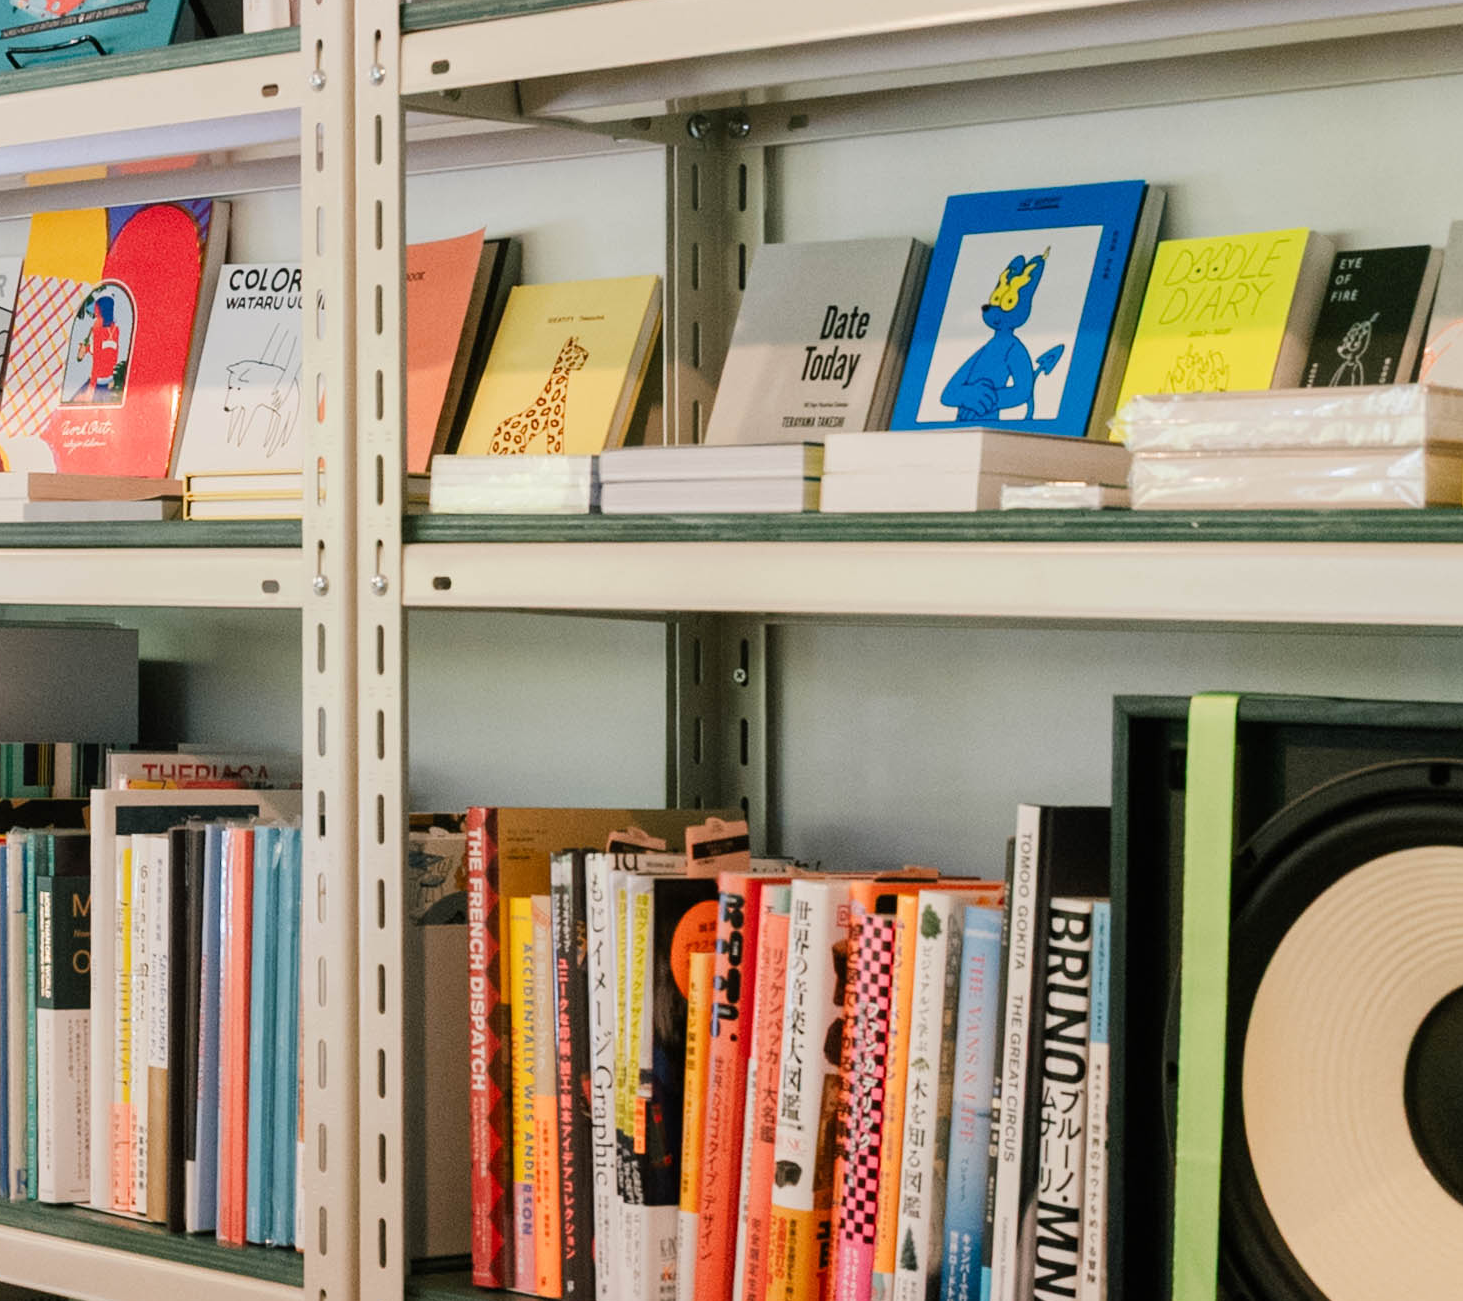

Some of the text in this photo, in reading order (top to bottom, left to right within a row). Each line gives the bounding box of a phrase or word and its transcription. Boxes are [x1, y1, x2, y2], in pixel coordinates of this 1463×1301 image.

[1164, 239, 1292, 287] DOODLE
[1335, 273, 1352, 286] OF
[1339, 257, 1363, 271] EYE
[225, 294, 283, 311] WATARU
[1159, 281, 1274, 326] DIARY
[1330, 288, 1359, 303] FIRE
[819, 303, 872, 341] Date
[801, 344, 862, 390] Today
[1011, 833, 1033, 971] TOMOO GOKITA
[467, 826, 487, 1092] THE FRENCH DISPATCH
[1041, 907, 1092, 1085] BRUNO
[522, 943, 535, 1237] ACCIDENTALLY WES ANDERSON
[1003, 995, 1024, 1163] THE GREAT CIRCUS
[902, 1078, 929, 1219] 木を知る図鑑
